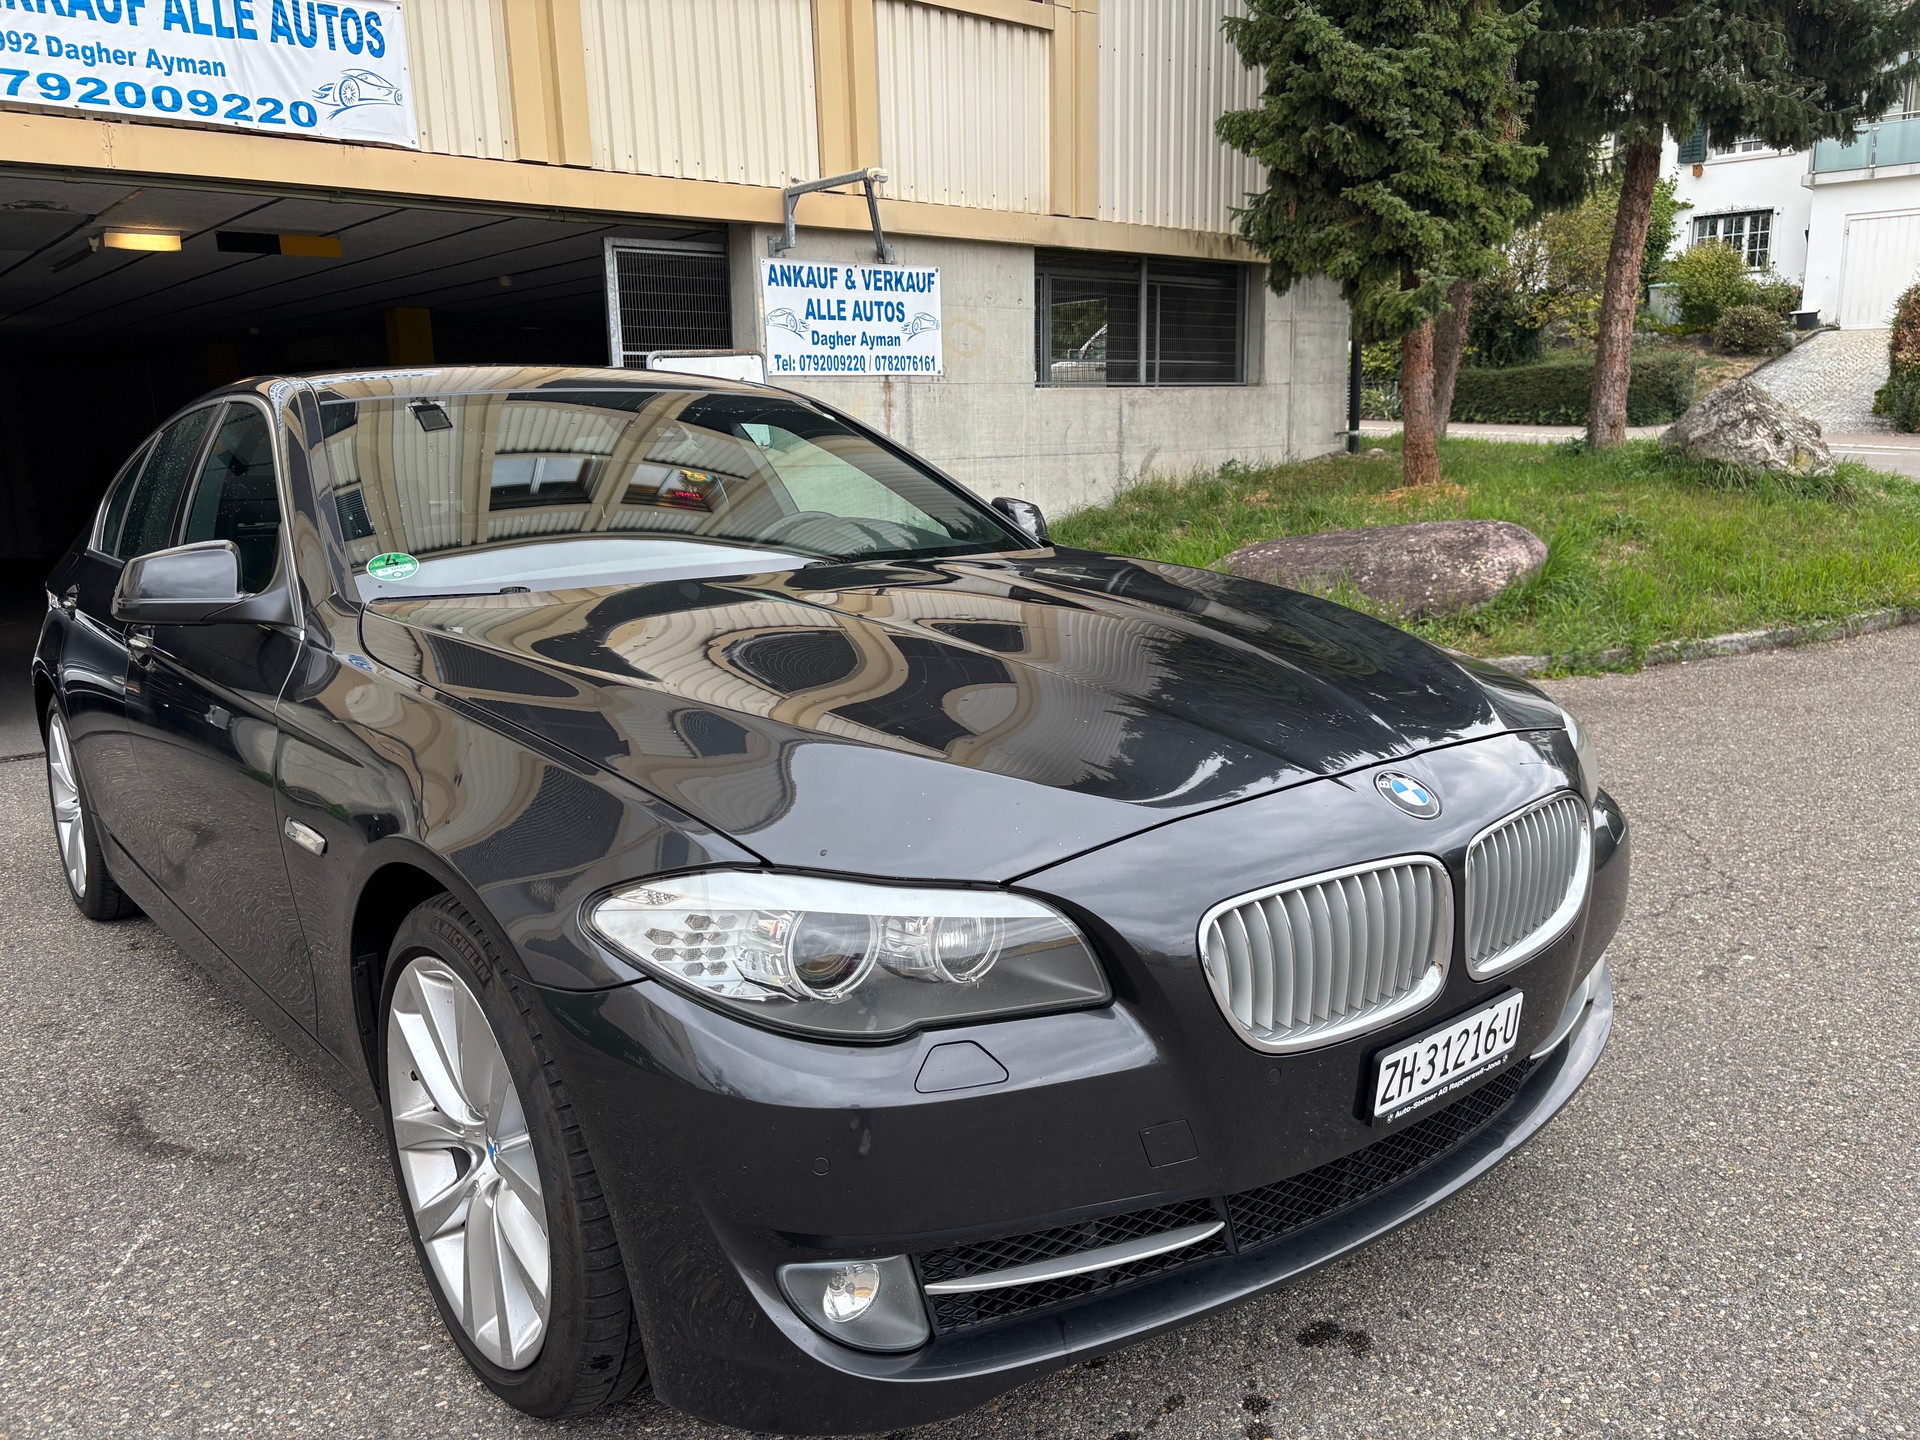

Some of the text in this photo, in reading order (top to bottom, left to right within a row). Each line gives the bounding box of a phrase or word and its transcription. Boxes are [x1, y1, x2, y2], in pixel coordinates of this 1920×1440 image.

[163, 0, 258, 40] ALLE
[270, 0, 386, 59] AUTOS
[45, 35, 137, 67] Dagher
[145, 48, 227, 77] Ayman
[0, 68, 318, 128] 792009220
[768, 264, 935, 293] ANKAUF & VERKAUF
[805, 298, 906, 323] ALLE AUTOS
[811, 330, 901, 351] Dagher Ayman
[774, 354, 796, 372] Tel:
[799, 355, 866, 372] 0792009220
[875, 355, 936, 372] 0782076161
[440, 923, 492, 982] MICHELIN
